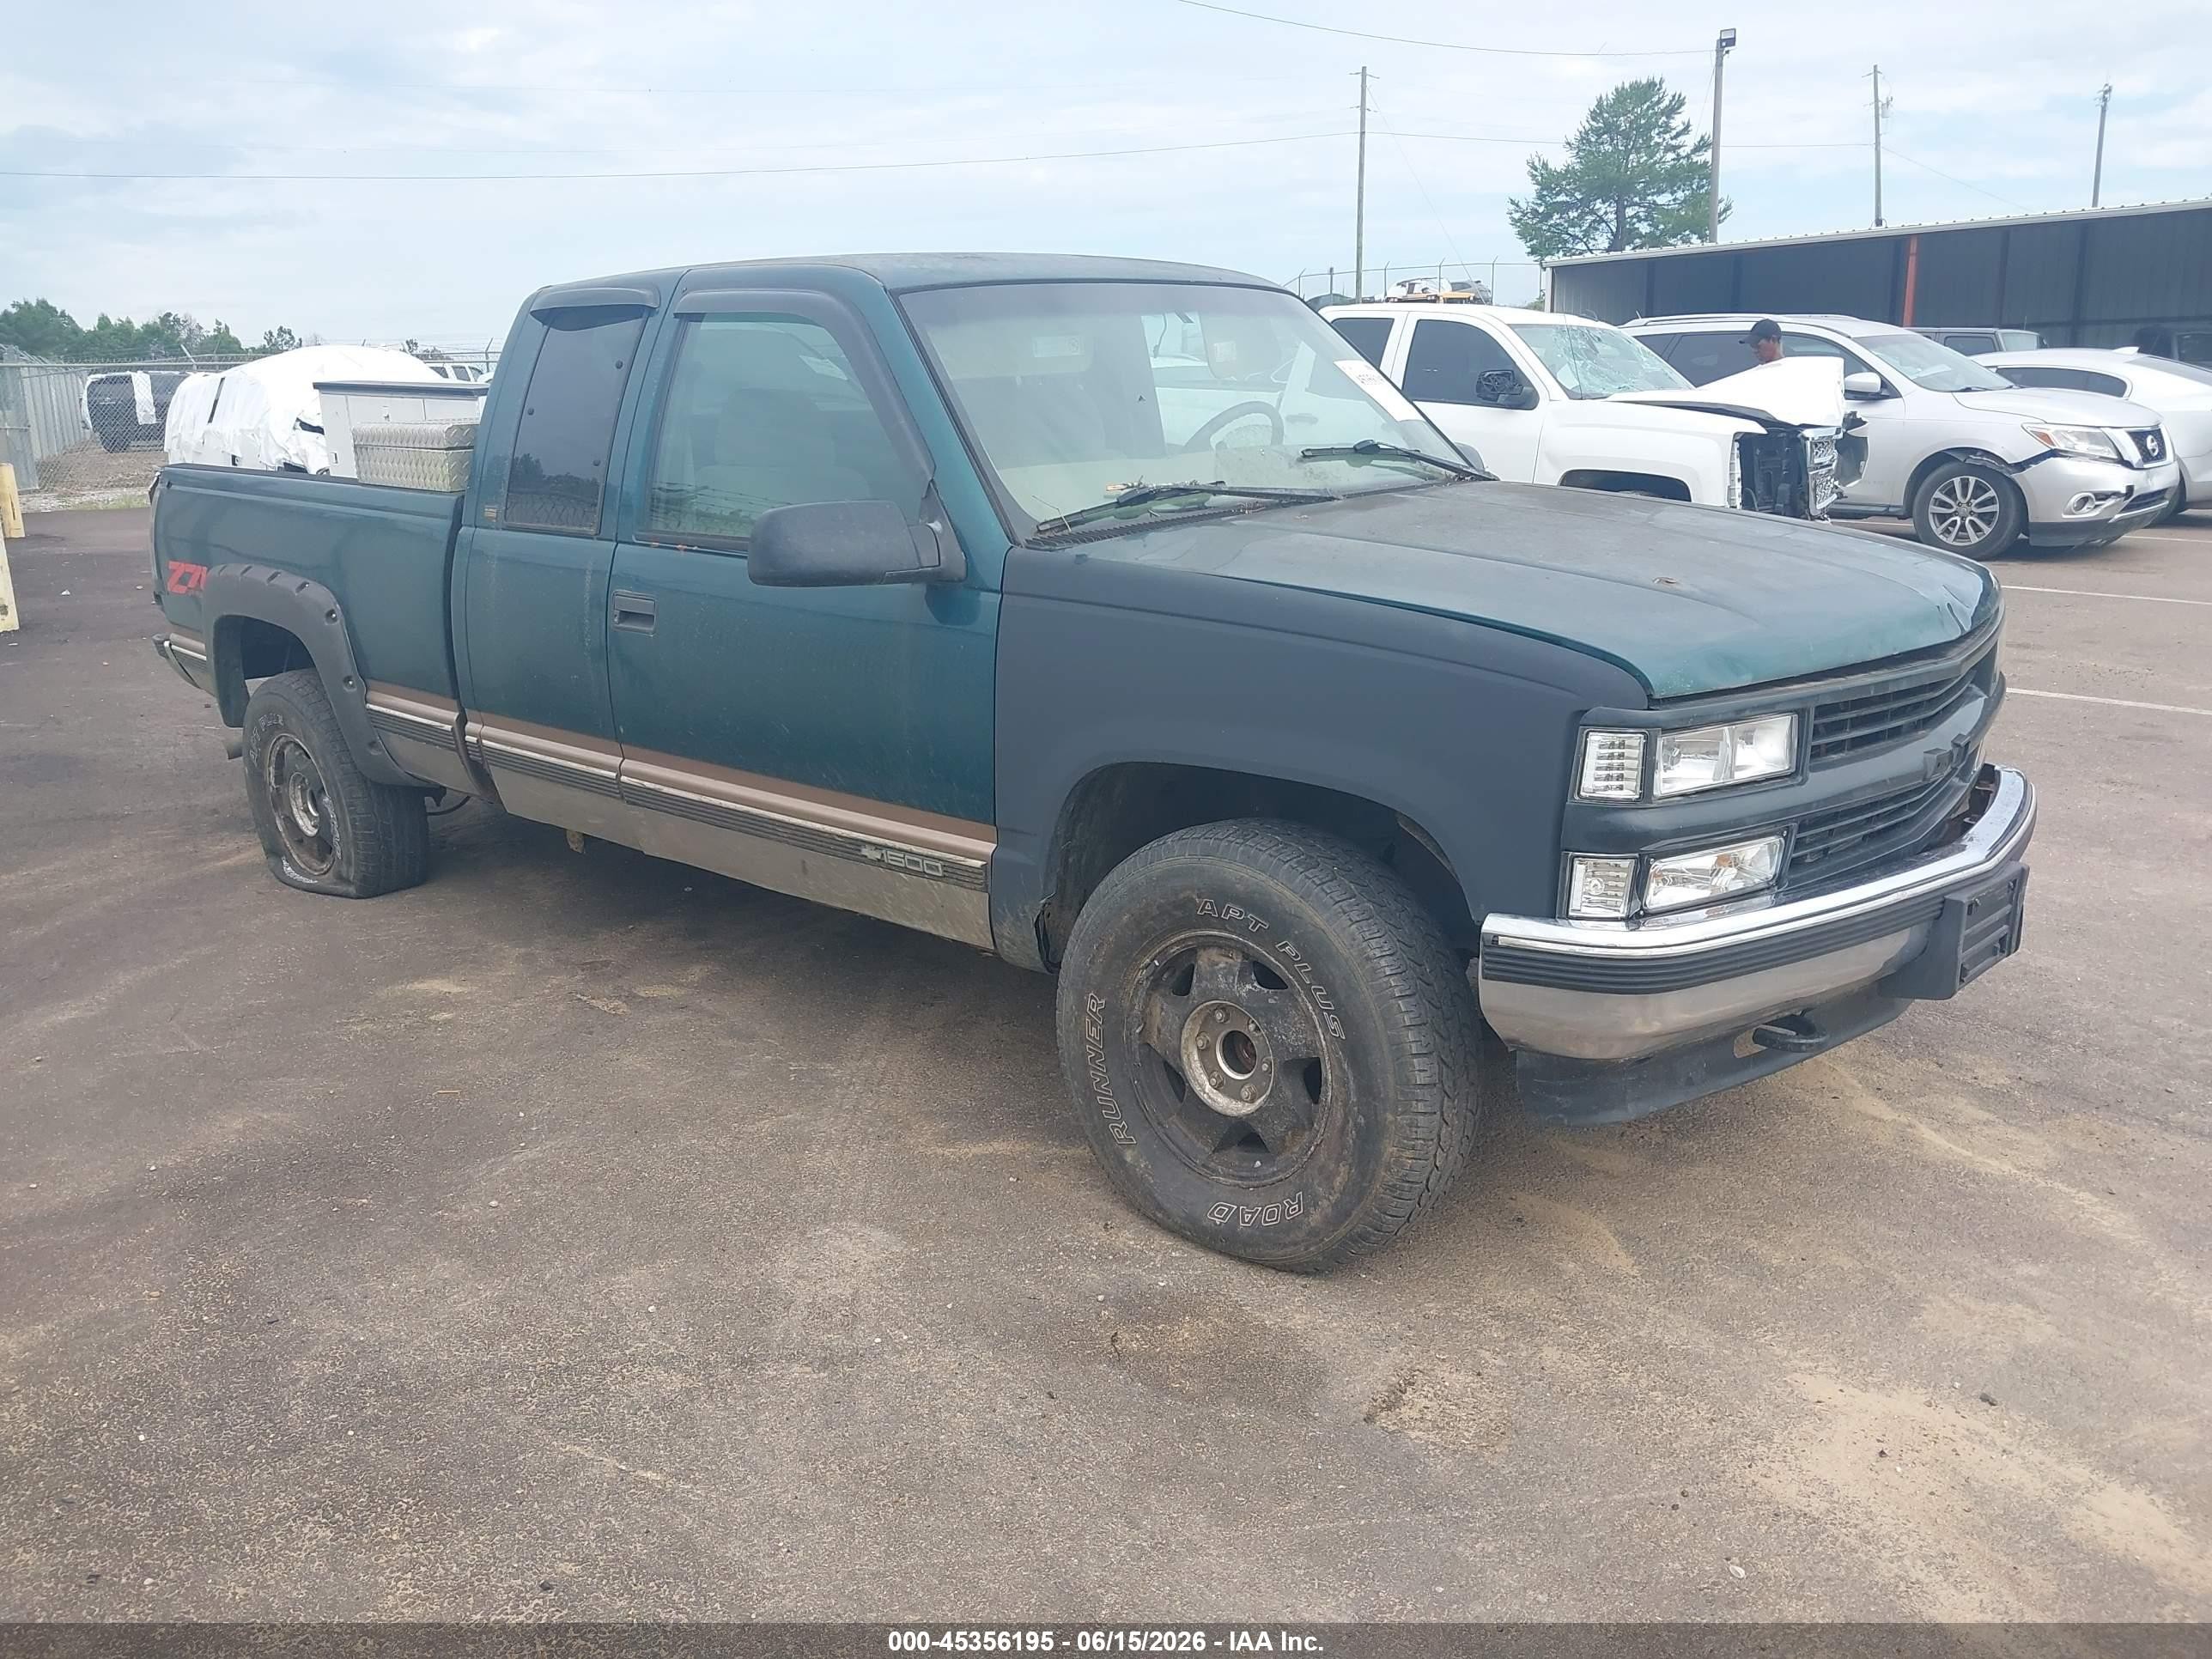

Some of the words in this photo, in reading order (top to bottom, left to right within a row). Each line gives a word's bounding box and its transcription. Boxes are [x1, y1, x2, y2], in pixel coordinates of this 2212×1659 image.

[882, 848, 943, 877] 1500
[1197, 898, 1269, 933] APT
[1275, 940, 1346, 1040] PLUS
[1085, 993, 1137, 1145] RUNNER
[1206, 1191, 1304, 1226] ROAD
